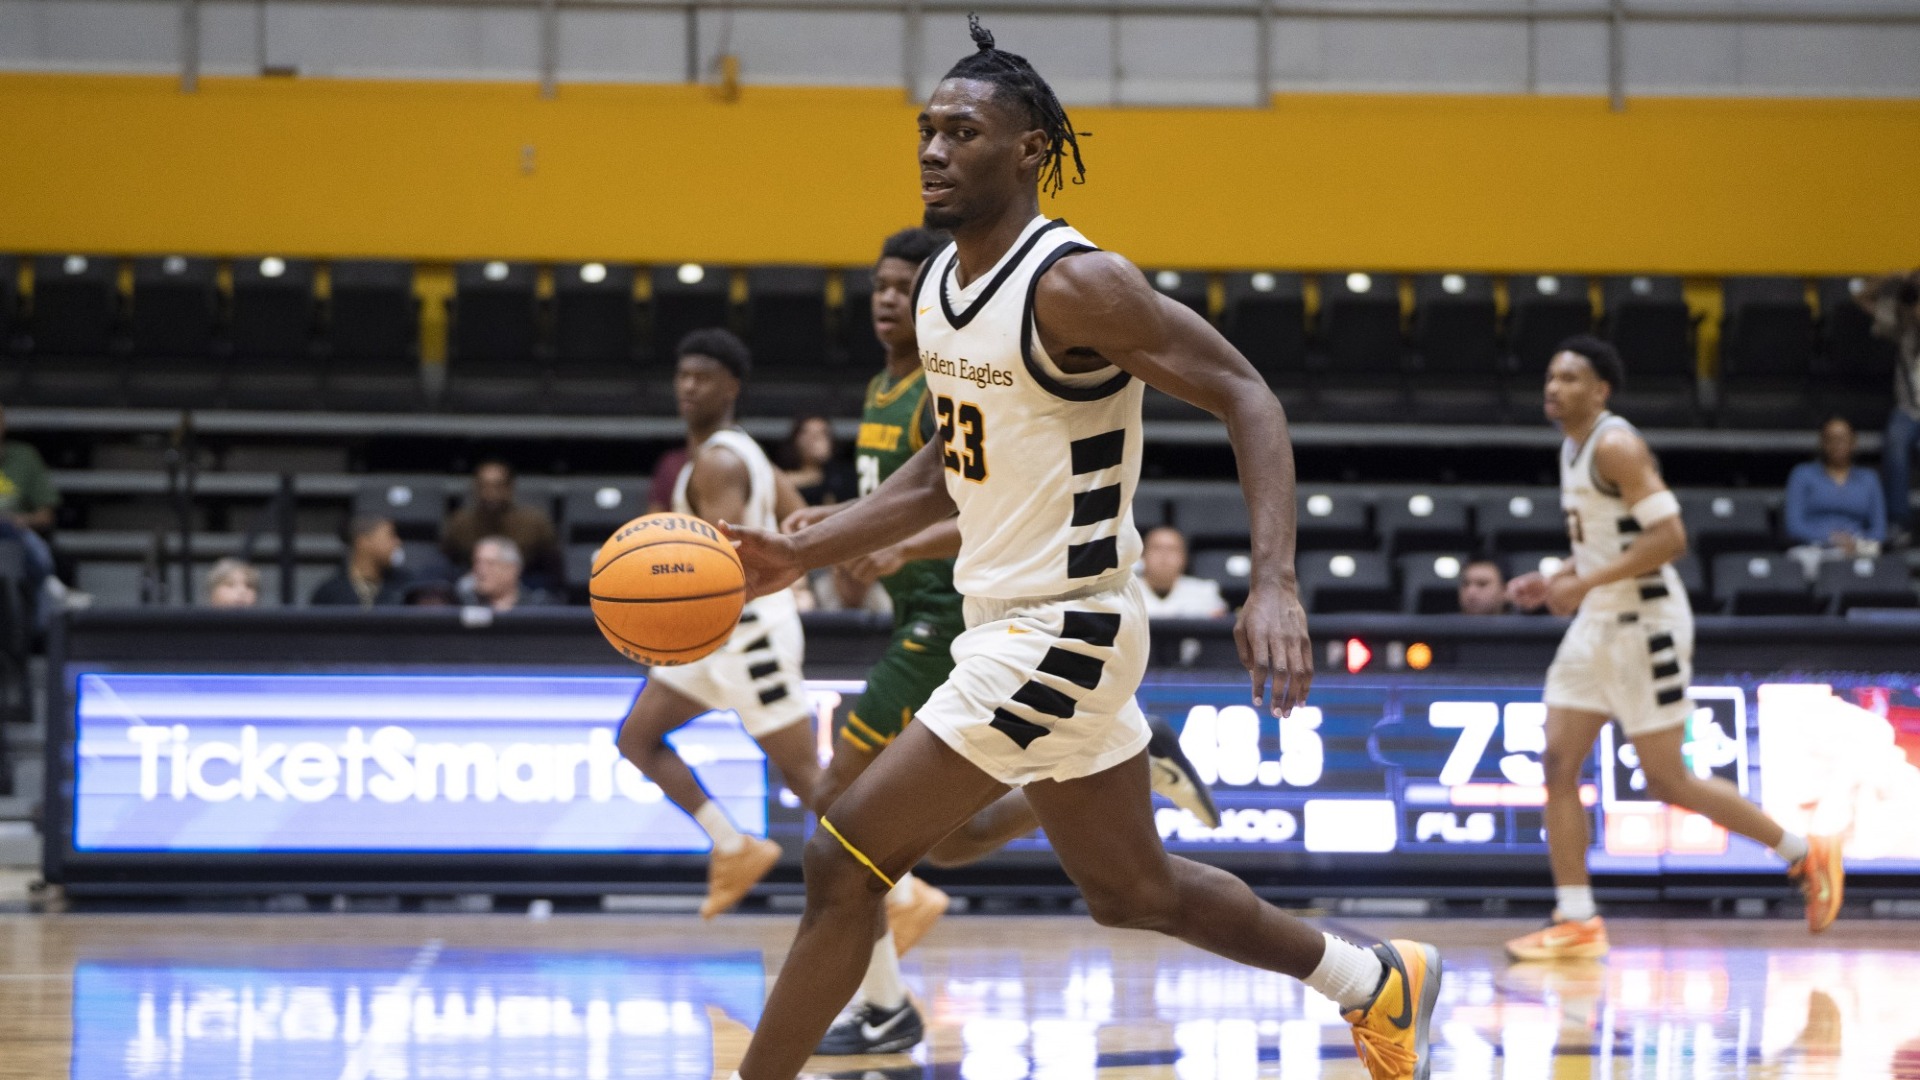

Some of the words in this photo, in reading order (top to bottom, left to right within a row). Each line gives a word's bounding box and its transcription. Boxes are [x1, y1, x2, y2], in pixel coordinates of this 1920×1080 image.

[921, 351, 956, 377] olden
[959, 358, 1014, 389] Eagles
[937, 393, 990, 485] 23
[616, 517, 719, 543] Wilson
[651, 563, 685, 576] NFHS
[1416, 811, 1496, 843] FLS
